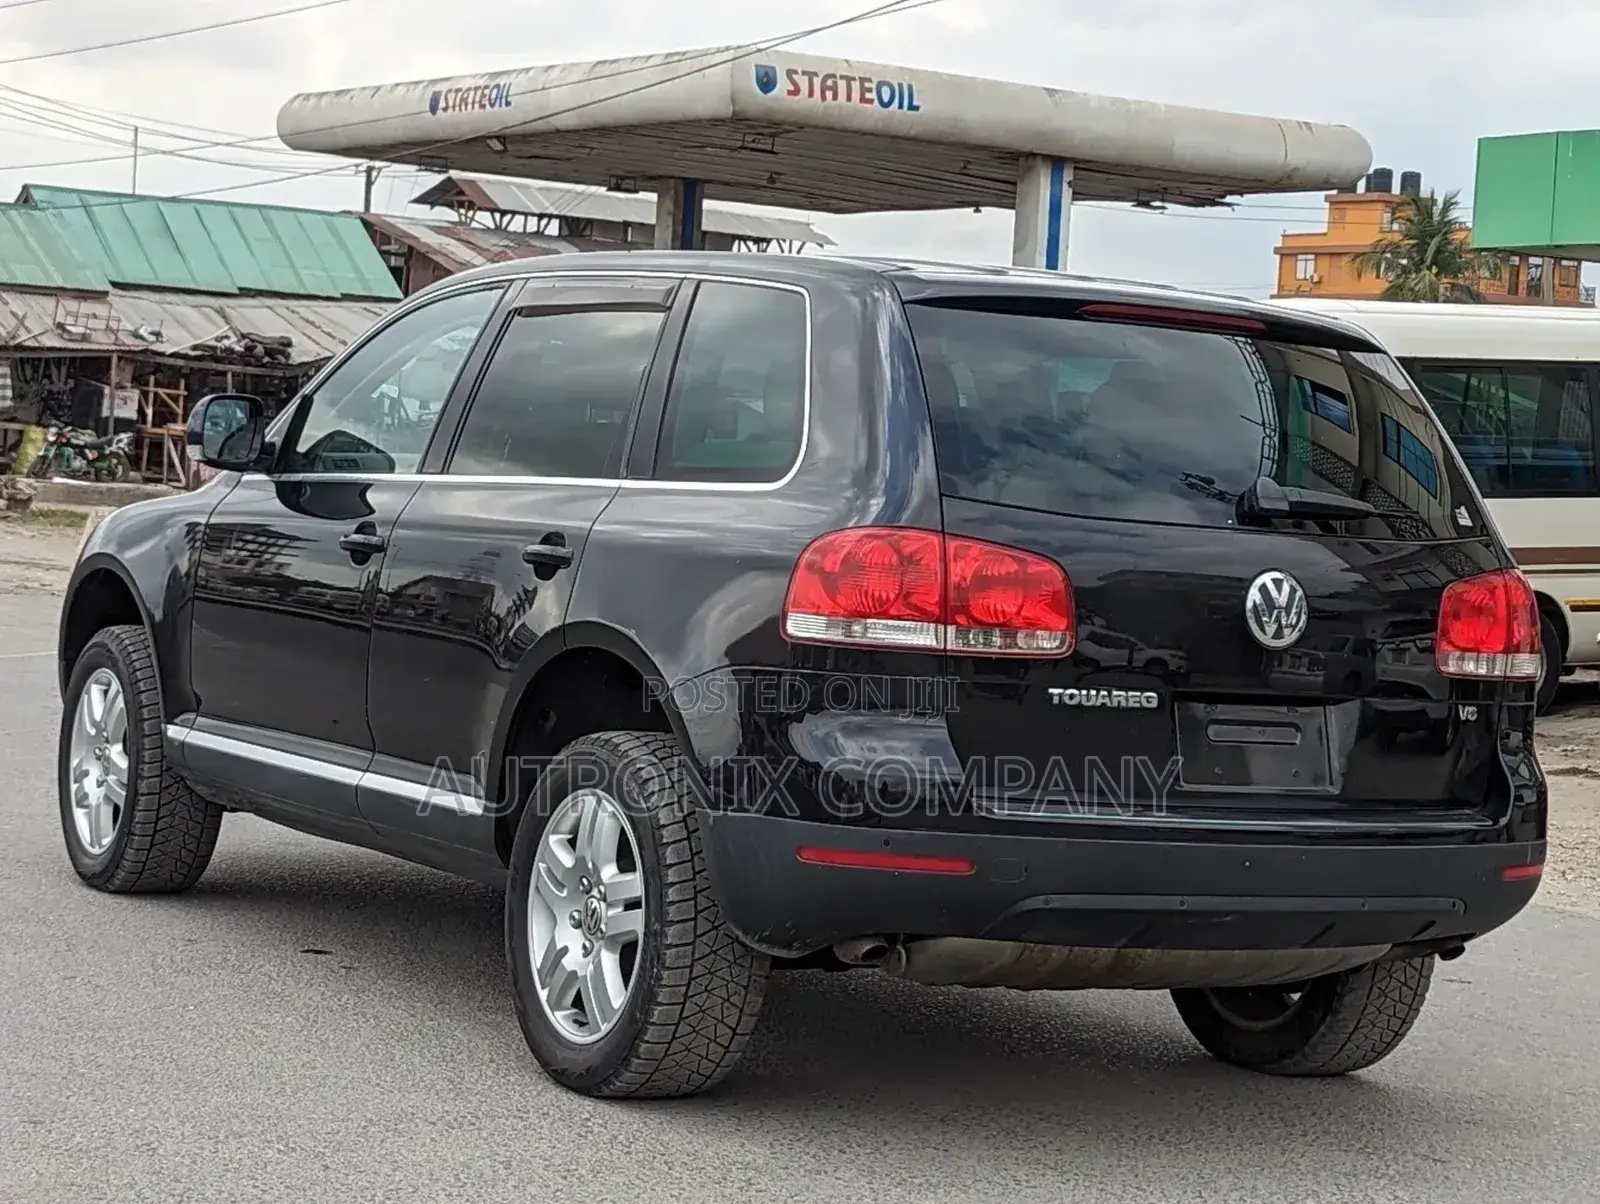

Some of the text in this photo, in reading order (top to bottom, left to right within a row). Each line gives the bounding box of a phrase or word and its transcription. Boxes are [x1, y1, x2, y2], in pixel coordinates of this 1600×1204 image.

[440, 82, 512, 113] STATEOIL
[785, 67, 921, 113] STATEOIL
[1245, 570, 1308, 649] VW
[1048, 687, 1158, 708] TOUAREG
